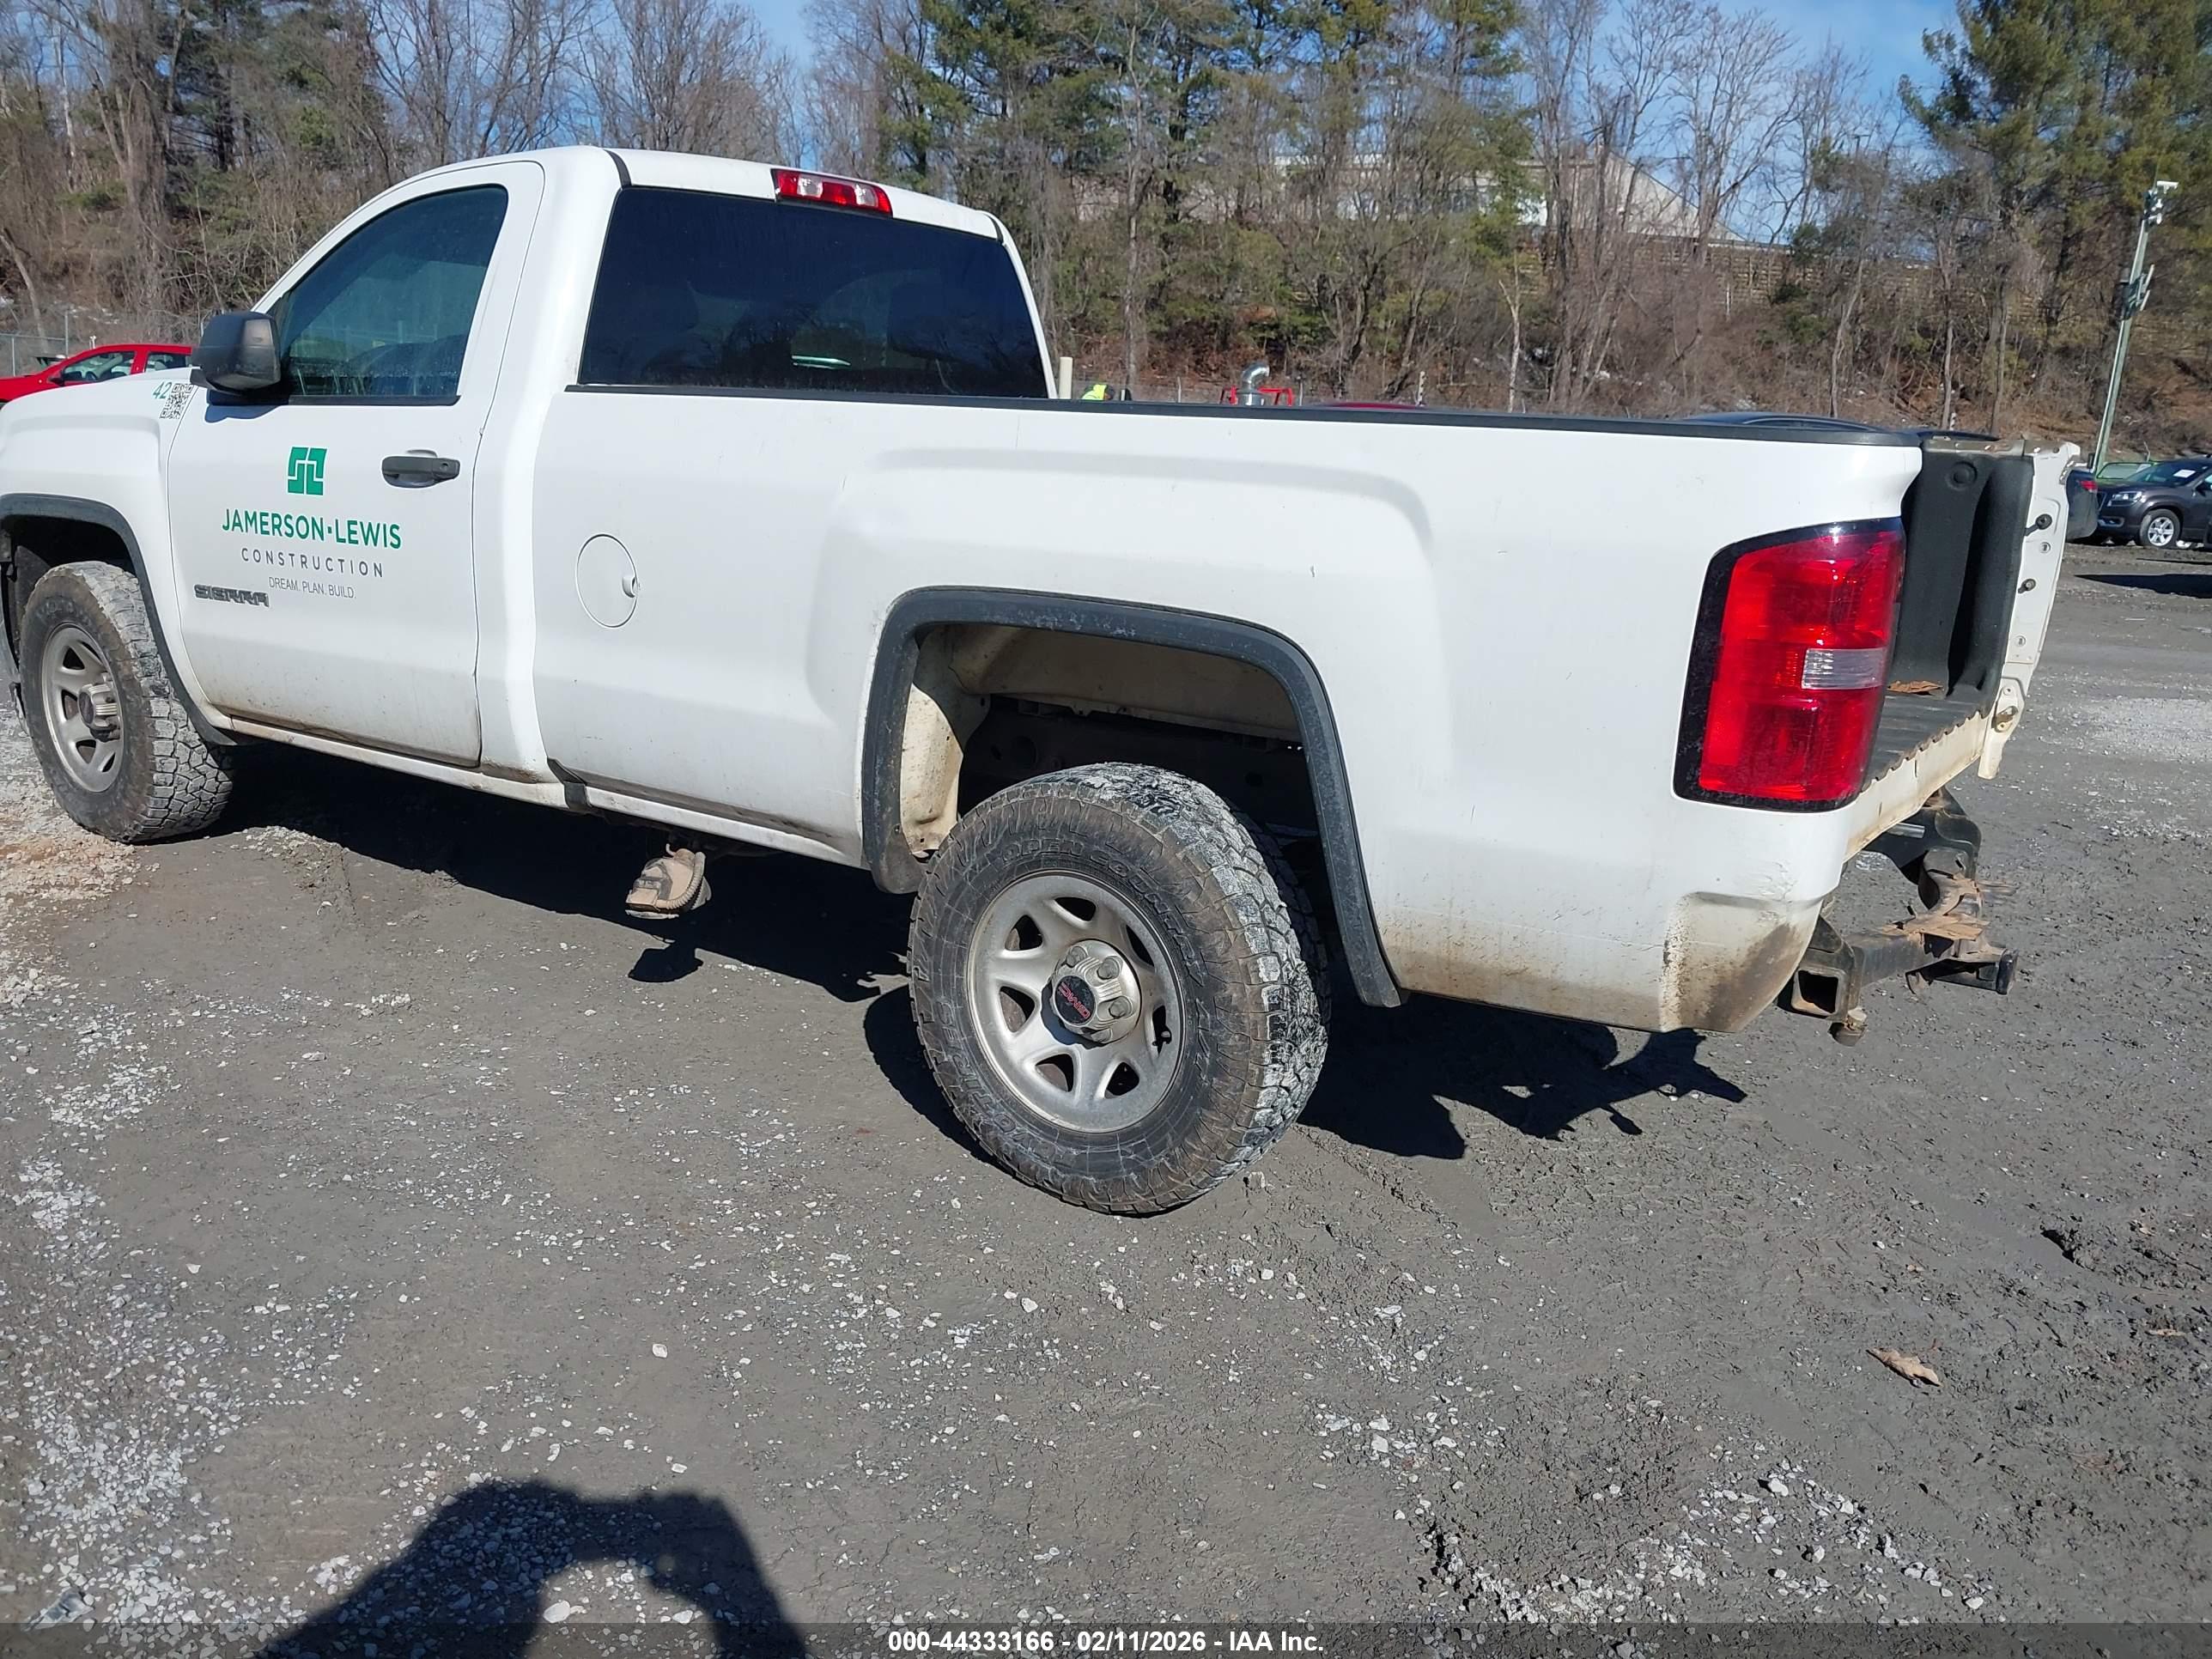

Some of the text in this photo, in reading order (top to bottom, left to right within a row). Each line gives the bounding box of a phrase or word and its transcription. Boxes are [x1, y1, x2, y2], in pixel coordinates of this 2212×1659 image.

[153, 381, 173, 399] 42
[241, 547, 383, 578] CONSTRUCTION
[194, 584, 270, 608] SIERRA
[269, 576, 356, 599] DREAM. PLAN. BUILD.
[1003, 838, 1085, 860] OPEN
[1058, 981, 1091, 1019] GMC
